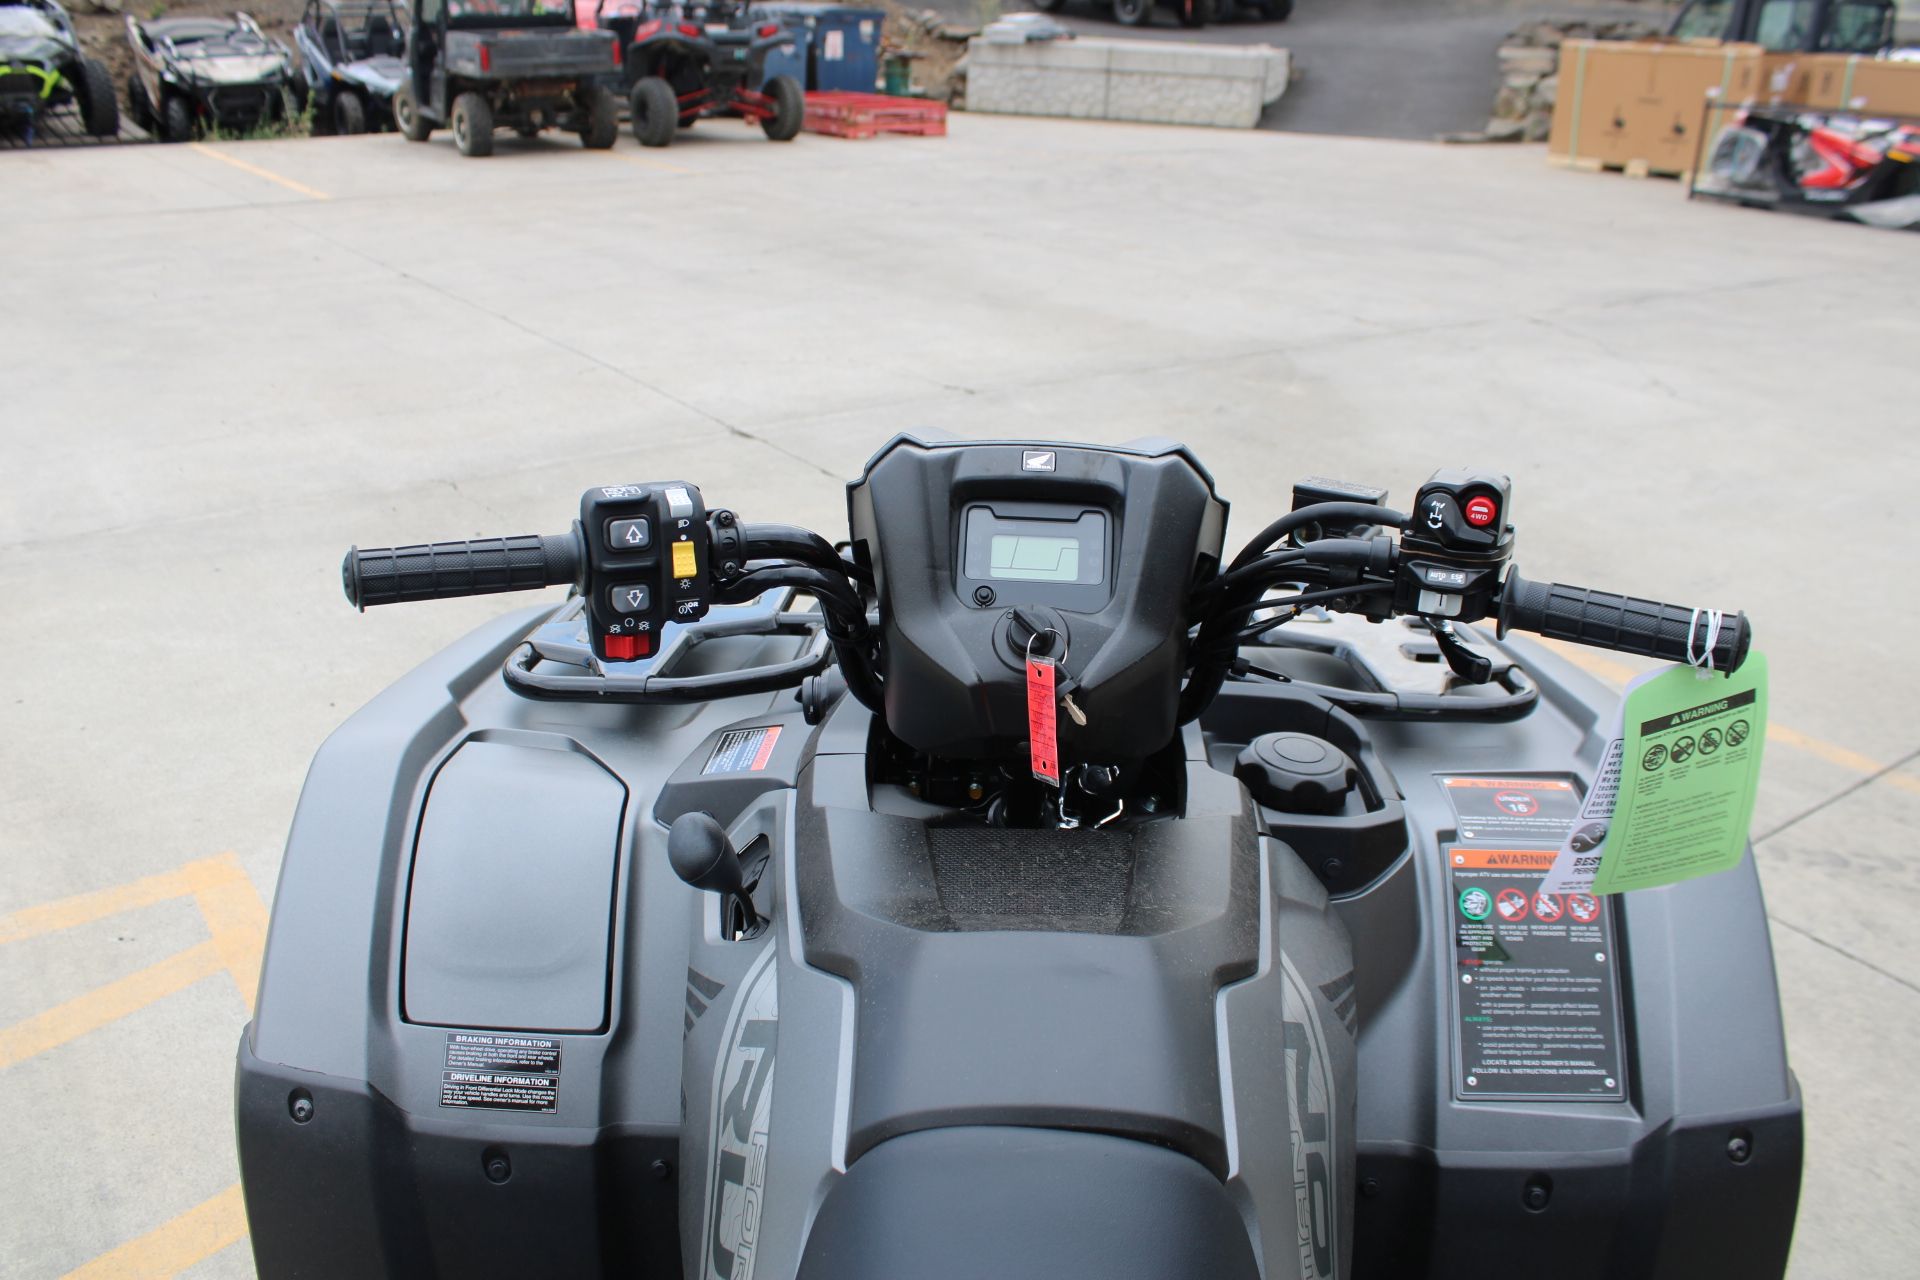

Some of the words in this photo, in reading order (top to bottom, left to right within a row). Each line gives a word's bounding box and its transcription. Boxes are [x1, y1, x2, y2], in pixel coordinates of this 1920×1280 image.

[1470, 513, 1488, 521] 4WD
[1681, 701, 1729, 722] WARNING
[1508, 803, 1529, 813] 16
[456, 1035, 493, 1044] BRAKING
[495, 1037, 552, 1048] INFORMATION
[451, 1073, 493, 1082] DRIVELINE
[494, 1076, 550, 1086] INFORMATION
